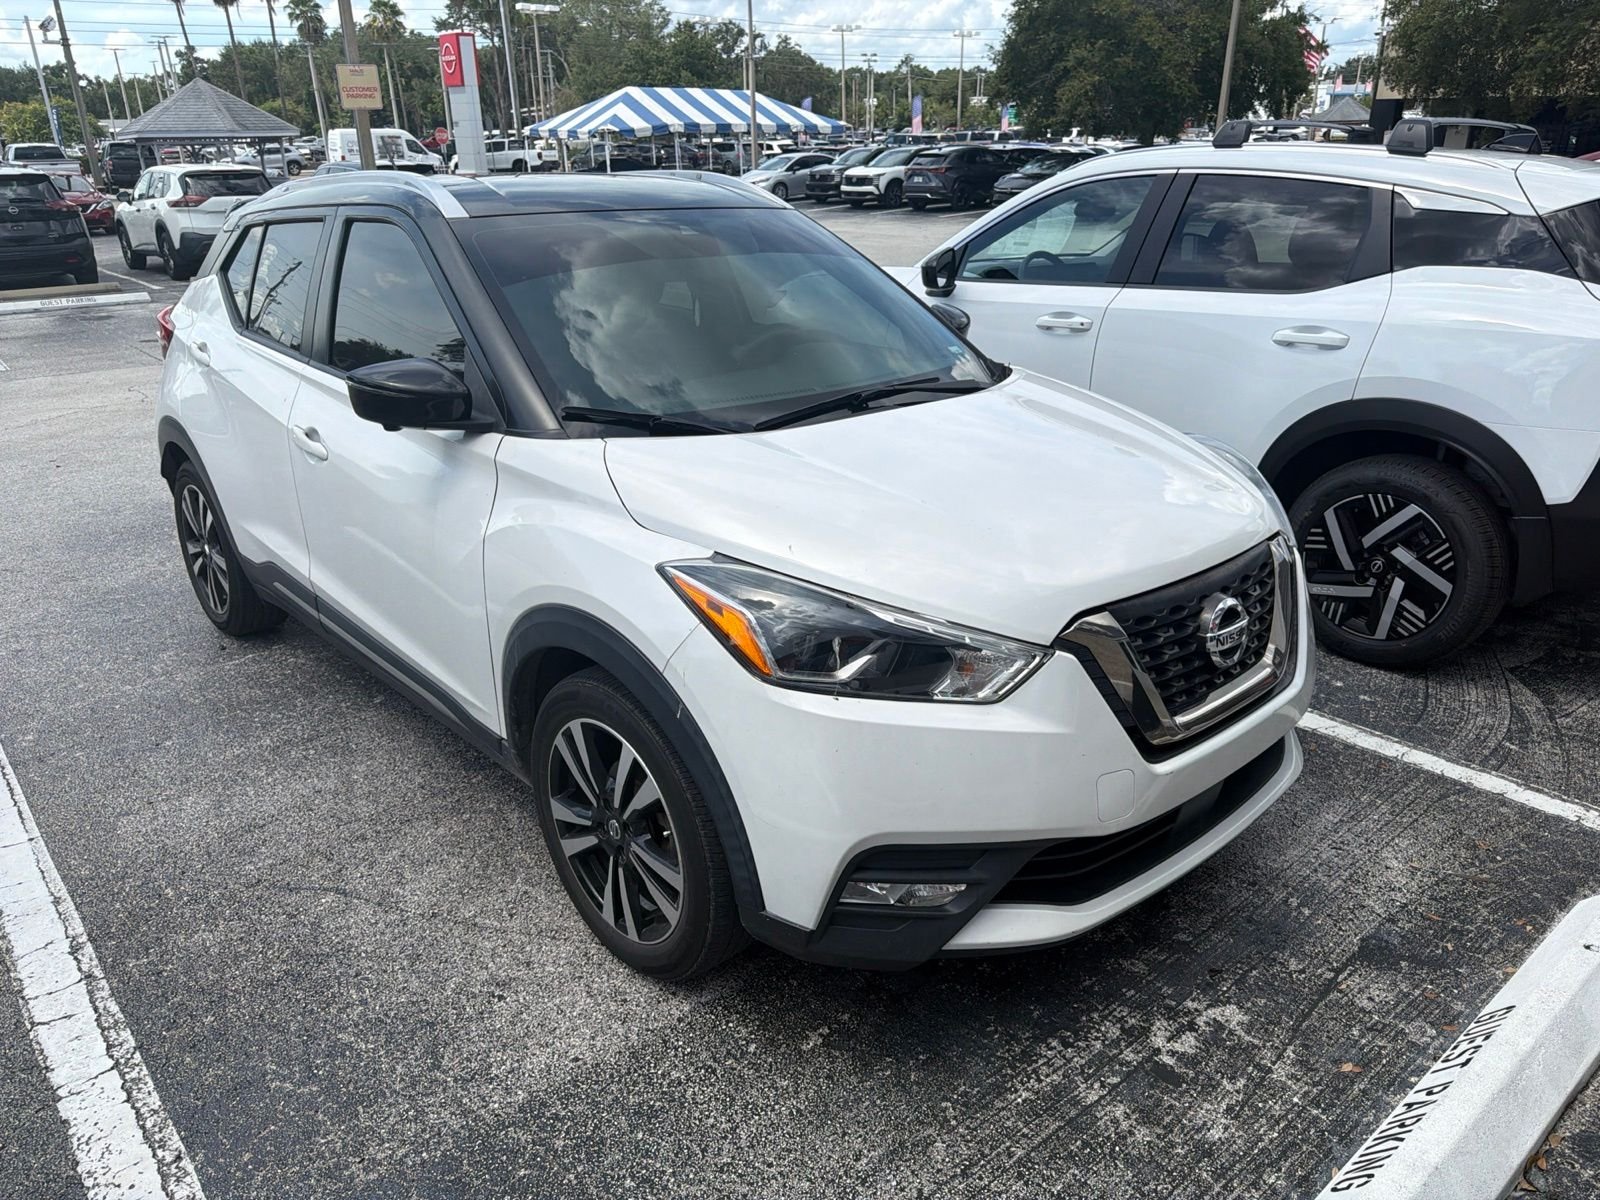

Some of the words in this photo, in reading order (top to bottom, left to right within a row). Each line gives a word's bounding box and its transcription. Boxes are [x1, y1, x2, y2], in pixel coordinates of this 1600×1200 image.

[40, 299, 63, 307] GUEST
[66, 297, 97, 305] PARKING
[1216, 630, 1245, 648] NISS
[1431, 1005, 1516, 1074] GUEST
[1330, 1080, 1454, 1193] PARKING
